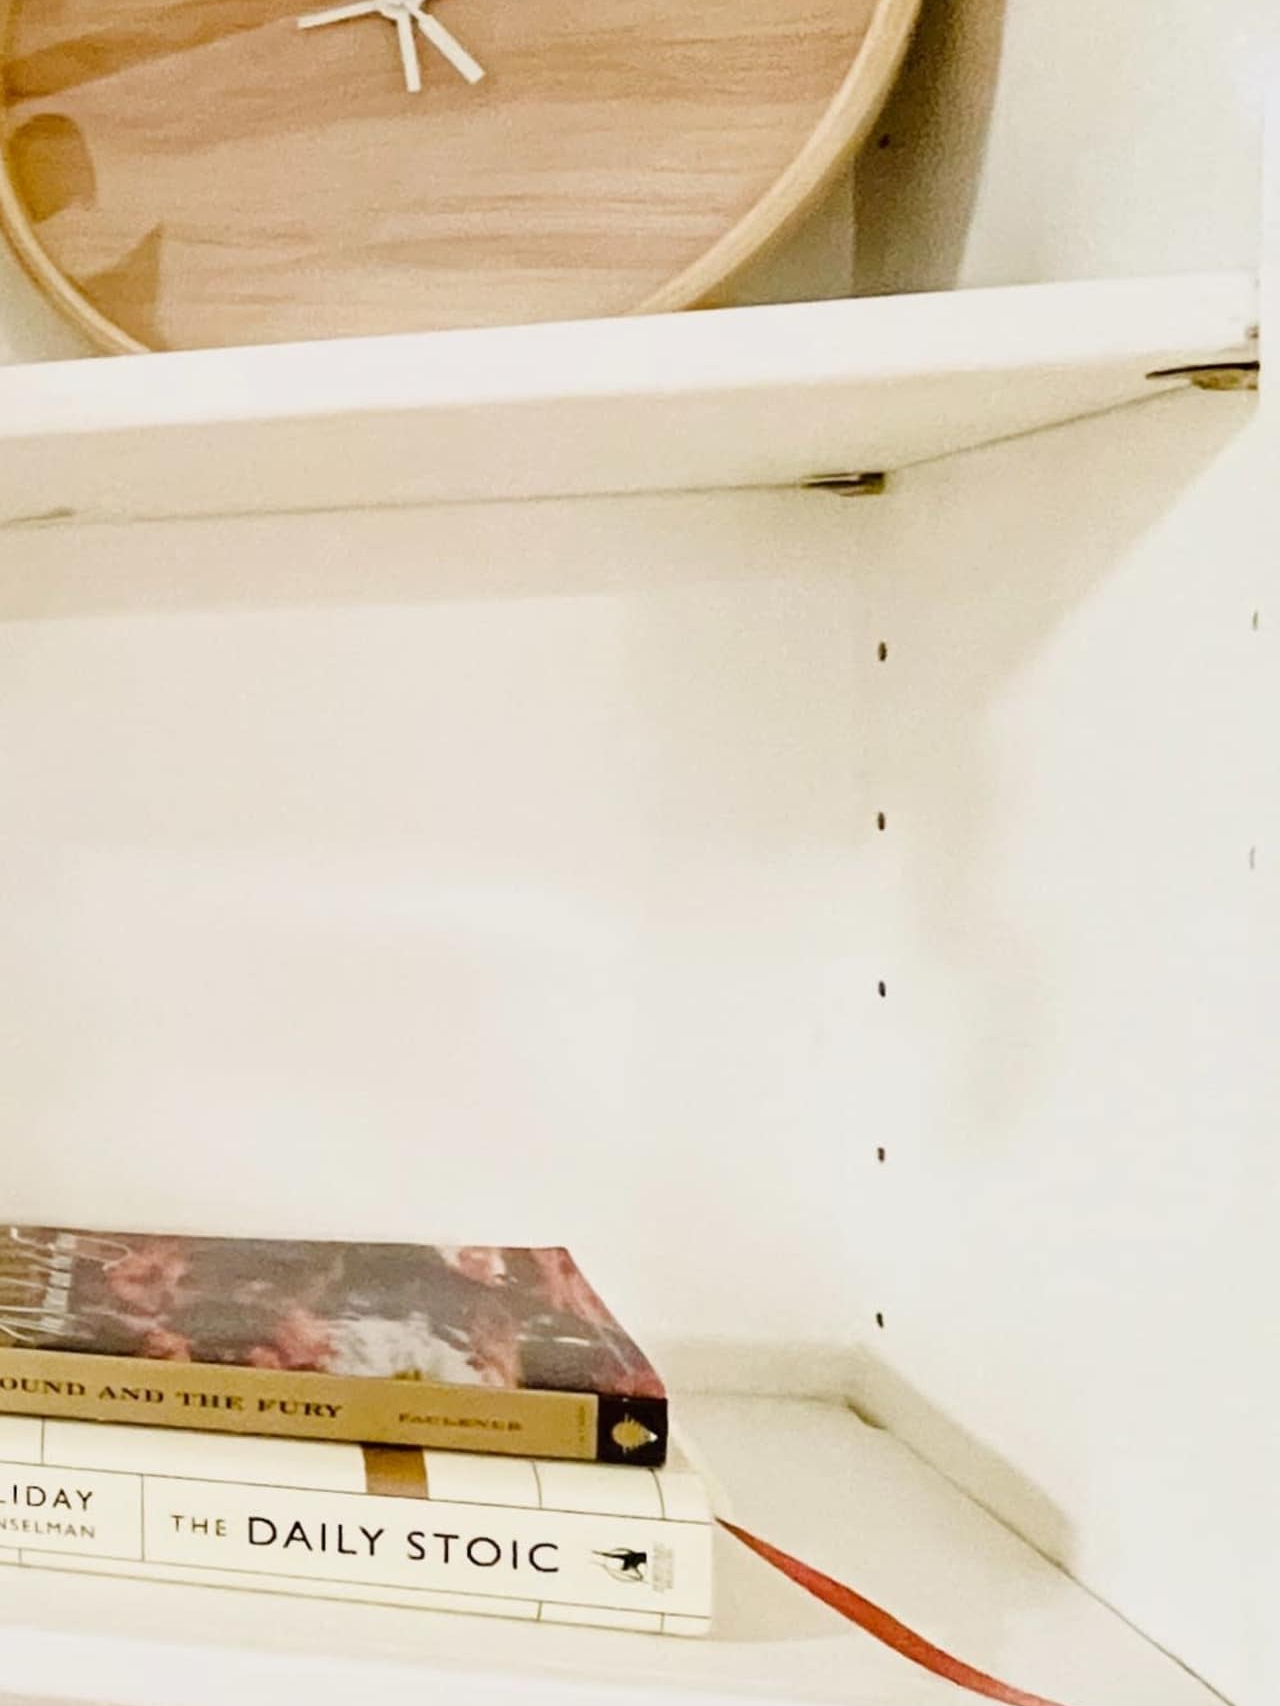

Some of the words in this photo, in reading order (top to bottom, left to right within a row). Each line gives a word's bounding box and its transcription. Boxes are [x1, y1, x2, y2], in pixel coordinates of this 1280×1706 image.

[98, 1384, 166, 1404] AND
[176, 1390, 246, 1411] THE
[257, 1397, 344, 1420] FURY
[169, 1514, 228, 1538] THE
[247, 1516, 385, 1557] DAILY
[406, 1530, 561, 1574] STOIC
